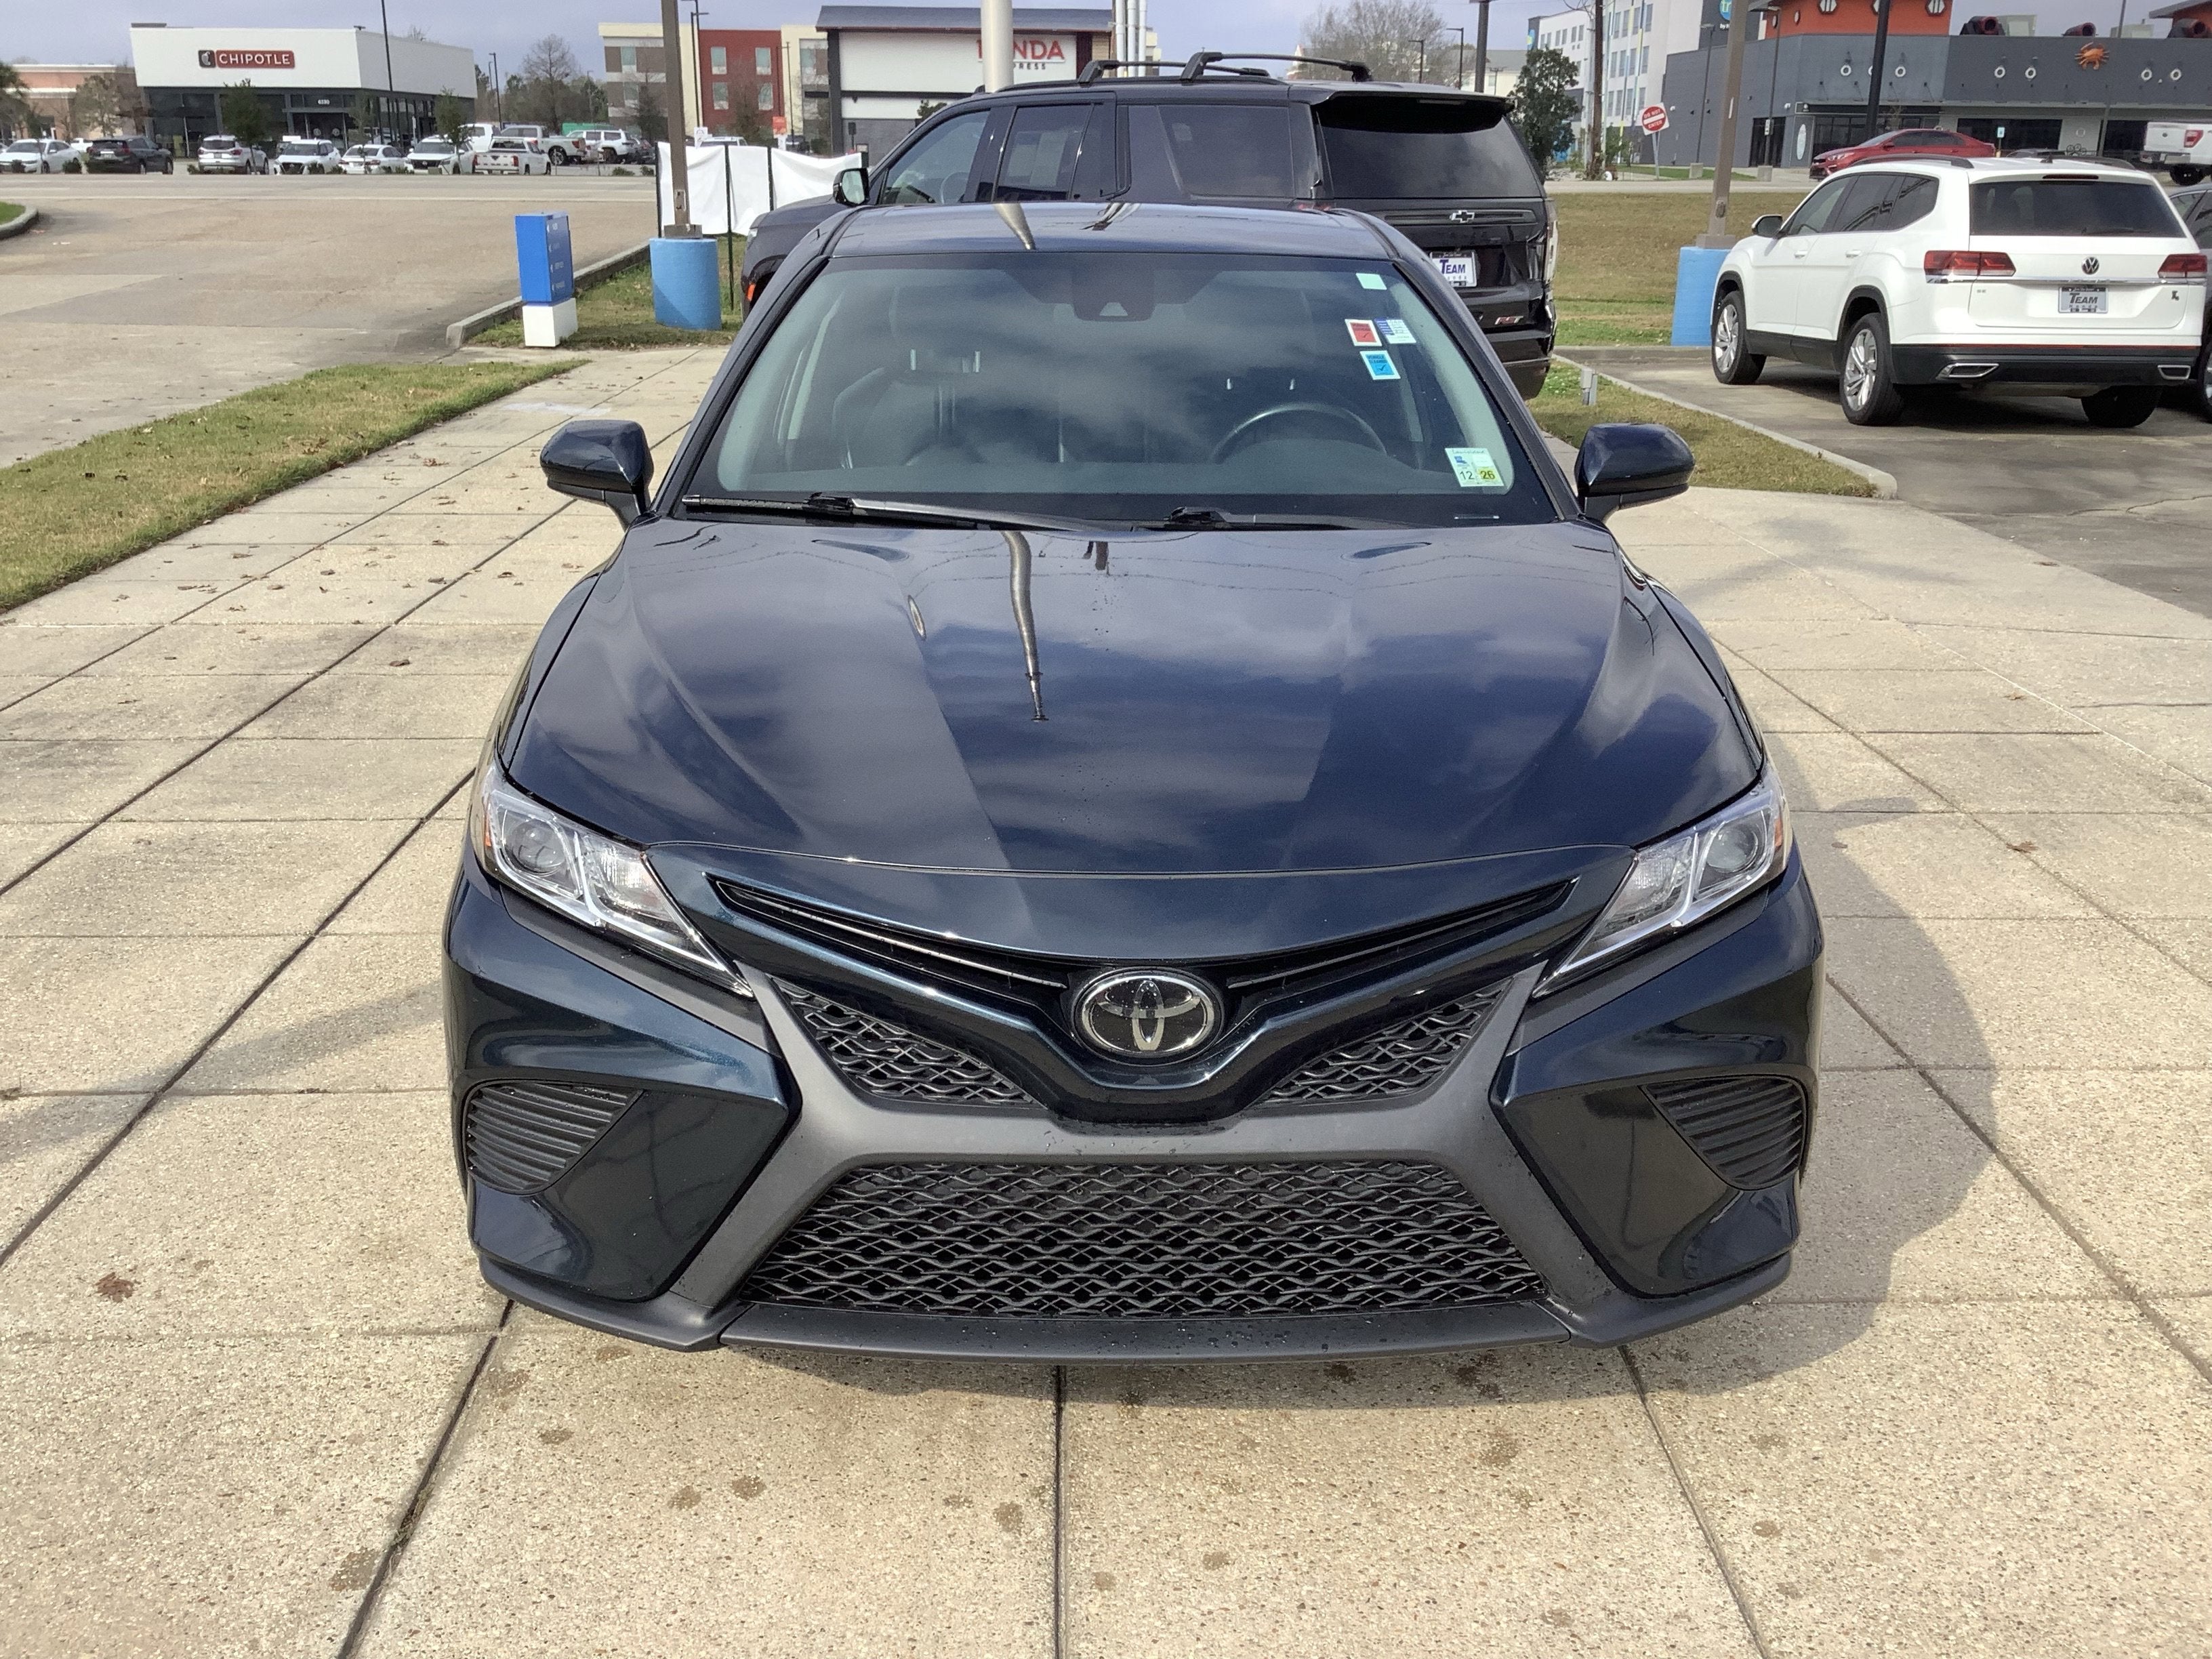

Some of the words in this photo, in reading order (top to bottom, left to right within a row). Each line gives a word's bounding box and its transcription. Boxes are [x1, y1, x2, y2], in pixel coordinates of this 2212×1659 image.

[219, 54, 291, 64] CHIPOTLE
[1460, 471, 1475, 480] 12
[1480, 470, 1496, 480] 26
